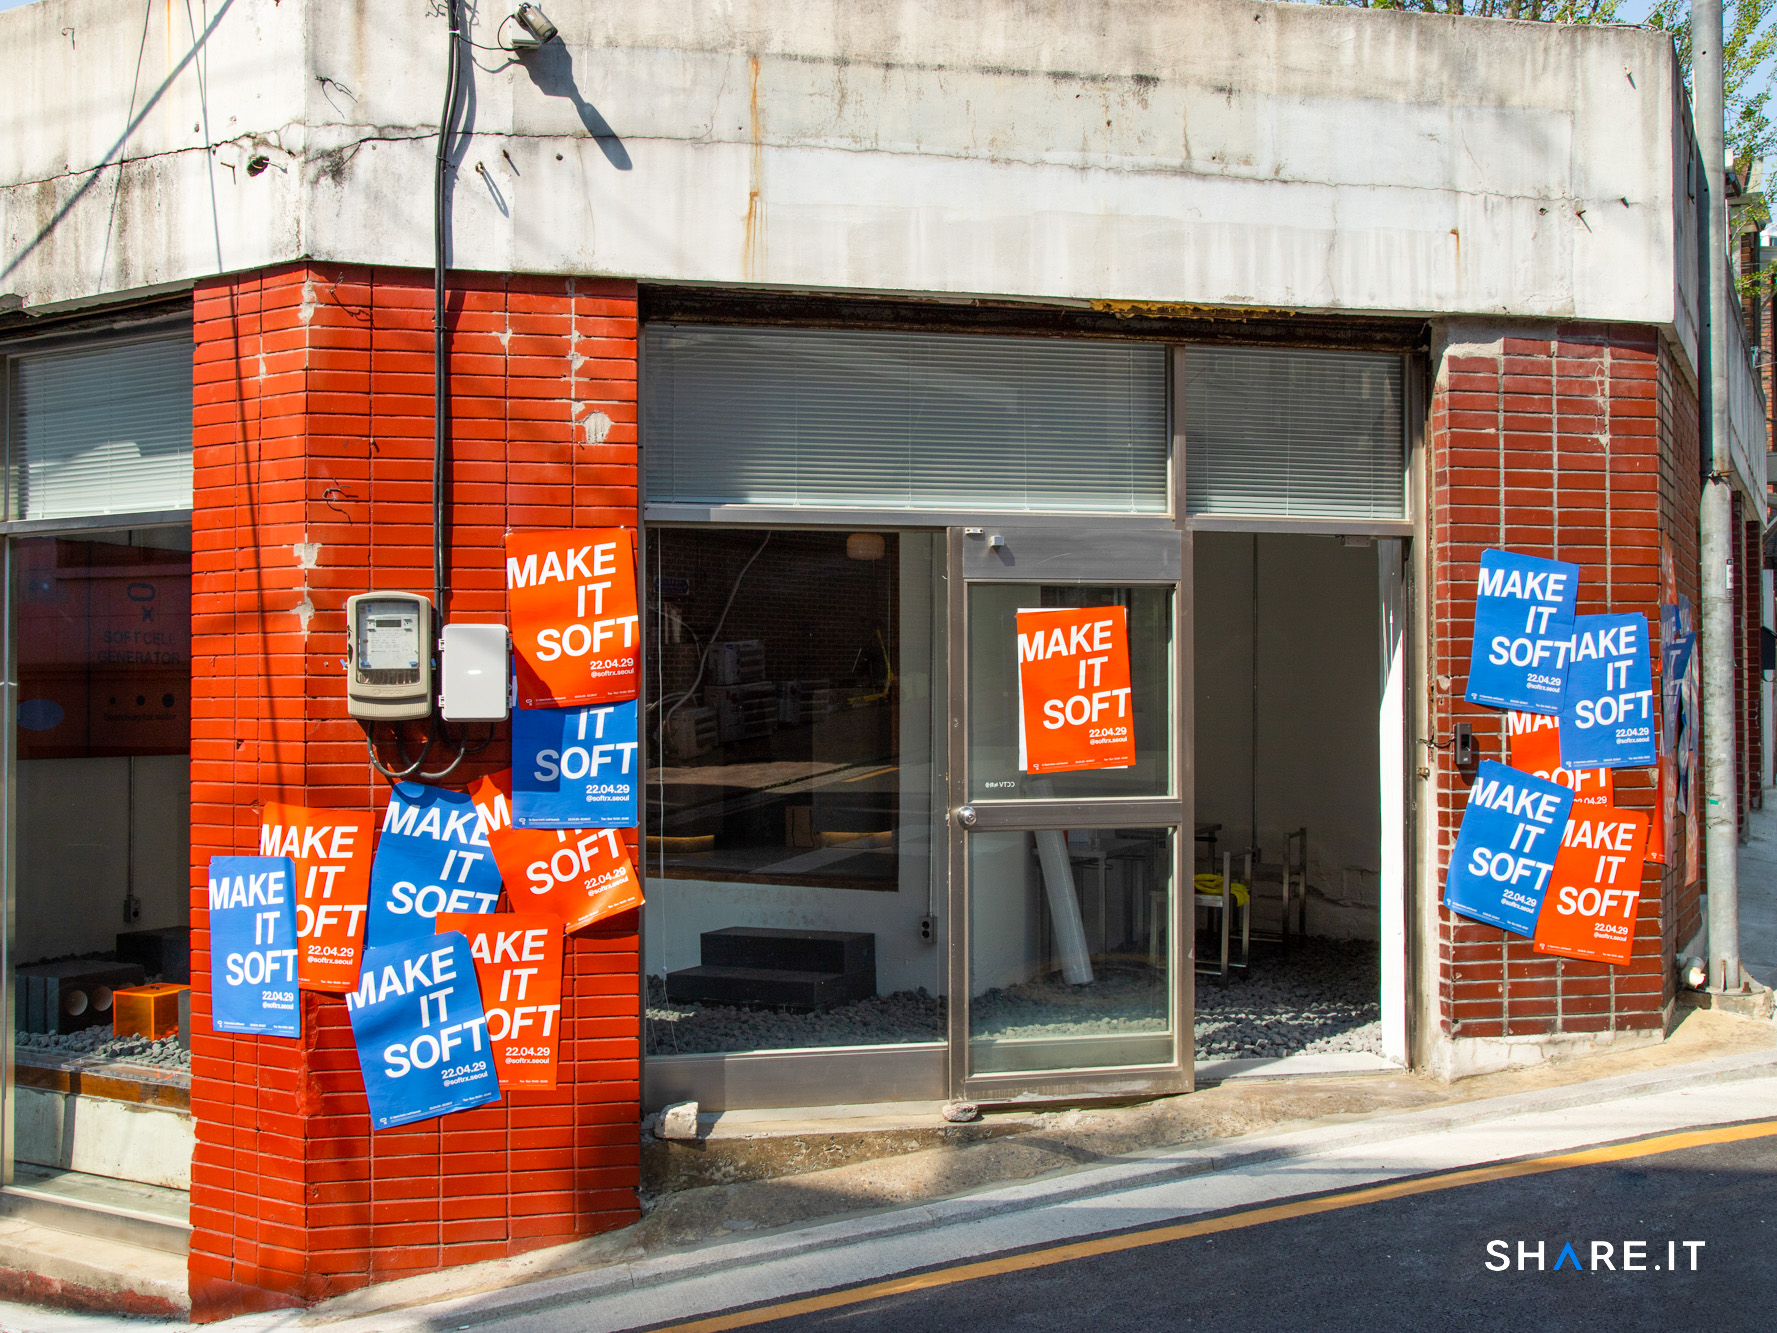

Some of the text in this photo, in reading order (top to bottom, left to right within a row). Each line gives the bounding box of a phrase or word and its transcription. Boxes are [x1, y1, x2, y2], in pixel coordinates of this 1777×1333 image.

[507, 541, 617, 590] MAKE
[577, 581, 611, 618] IT
[1477, 567, 1567, 602] MAKE
[1525, 605, 1557, 635] IT
[103, 630, 176, 646] SOFT CELL
[536, 614, 638, 662] SOFT
[1017, 619, 1113, 663] MAKE
[1488, 635, 1572, 669] SOFT
[97, 650, 180, 665] GENERATOR
[590, 658, 634, 670] 22.04.29
[591, 667, 634, 678] @softrx.seoul
[1078, 656, 1108, 689] IT
[1526, 673, 1561, 686] 22.04.29
[1606, 659, 1634, 691] IT
[577, 706, 614, 740] IT
[1042, 687, 1131, 729] SOFT
[1575, 689, 1653, 729] SOFT
[1089, 726, 1127, 738] 22.04.29
[1615, 727, 1650, 737] 22.04.29
[533, 741, 638, 782] SOFT
[586, 784, 630, 794] 22.04.29
[1532, 767, 1606, 792] OFT
[586, 794, 630, 802] @softrx.seoul
[1468, 777, 1561, 824] MAKE
[260, 824, 358, 859] MAKE
[1509, 822, 1546, 853] IT
[439, 849, 484, 883] IT
[526, 827, 620, 895] SOFT
[1468, 847, 1553, 891] SOFT
[1594, 855, 1626, 884] IT
[208, 871, 285, 910] MAKE
[304, 866, 345, 898] IT
[584, 866, 627, 890] 22.04.29
[588, 875, 629, 897] @softrx.seoul
[1502, 889, 1537, 907] 22.04.29
[1556, 886, 1640, 918] SOFT
[255, 911, 280, 945] IT
[297, 904, 367, 938] OFT
[1594, 922, 1629, 935] 22.04.29
[307, 956, 353, 965] @softrx.seoul
[308, 945, 354, 957] 22.04.29
[470, 928, 548, 964] AKE
[226, 949, 298, 986] SOFT
[345, 945, 457, 1012] MAKE
[262, 990, 294, 1002] 22.04.29
[499, 968, 538, 1001] IT
[420, 987, 454, 1028] IT
[485, 1004, 560, 1042] OFT
[383, 1016, 485, 1079] SOFT
[505, 1047, 550, 1056] 22.04.29
[505, 1056, 550, 1064] @softrx.seoul
[441, 1061, 487, 1079] 22.04.29
[443, 1071, 488, 1087] @softrx.seoul
